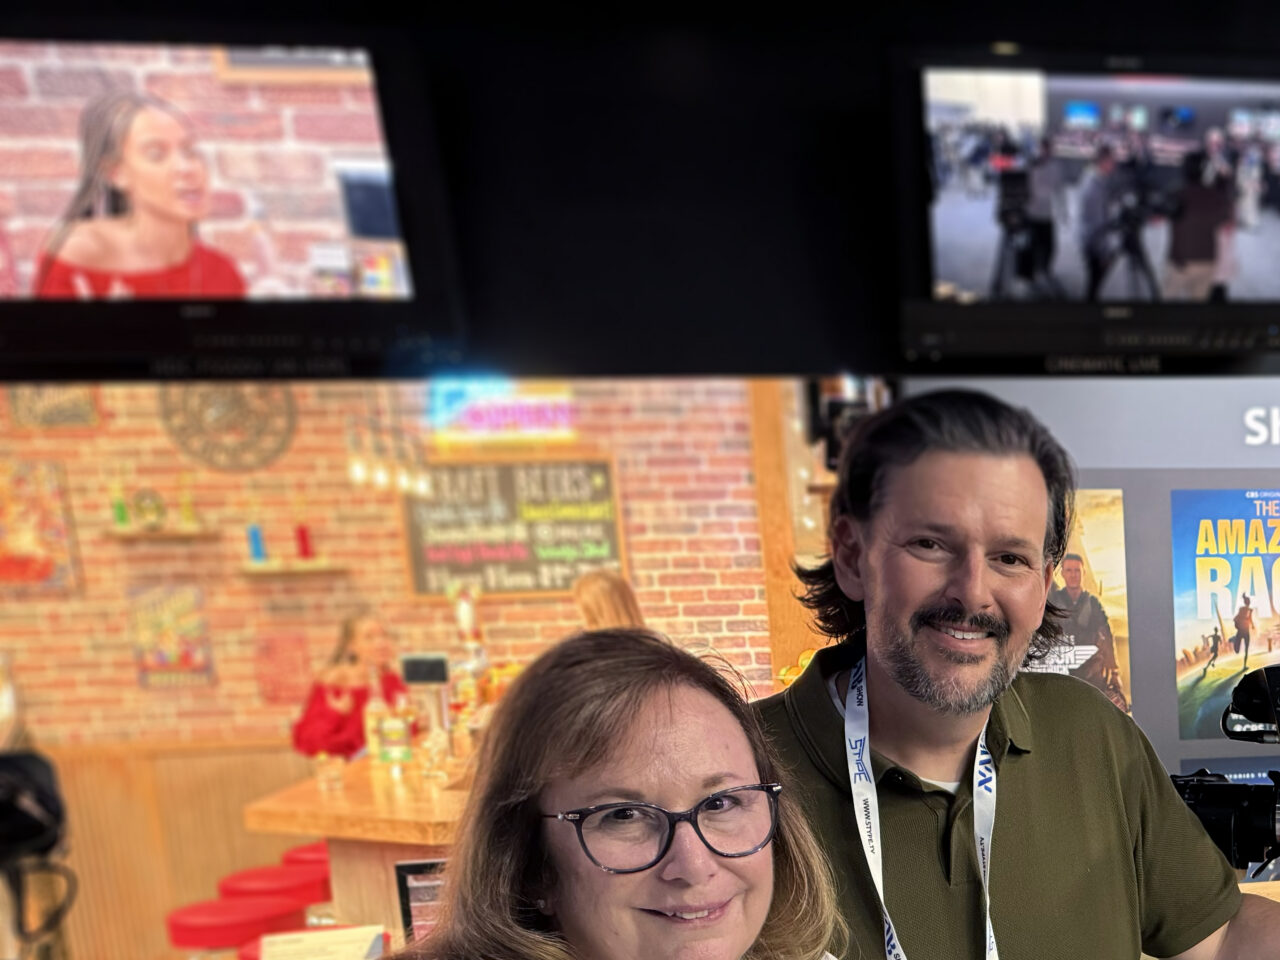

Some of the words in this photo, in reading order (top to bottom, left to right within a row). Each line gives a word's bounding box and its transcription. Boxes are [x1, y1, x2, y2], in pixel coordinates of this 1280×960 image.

[1245, 491, 1259, 499] CBS
[1253, 500, 1280, 516] THE
[856, 685, 864, 707] SHOW
[862, 798, 876, 855] WWW.STYPE.TV
